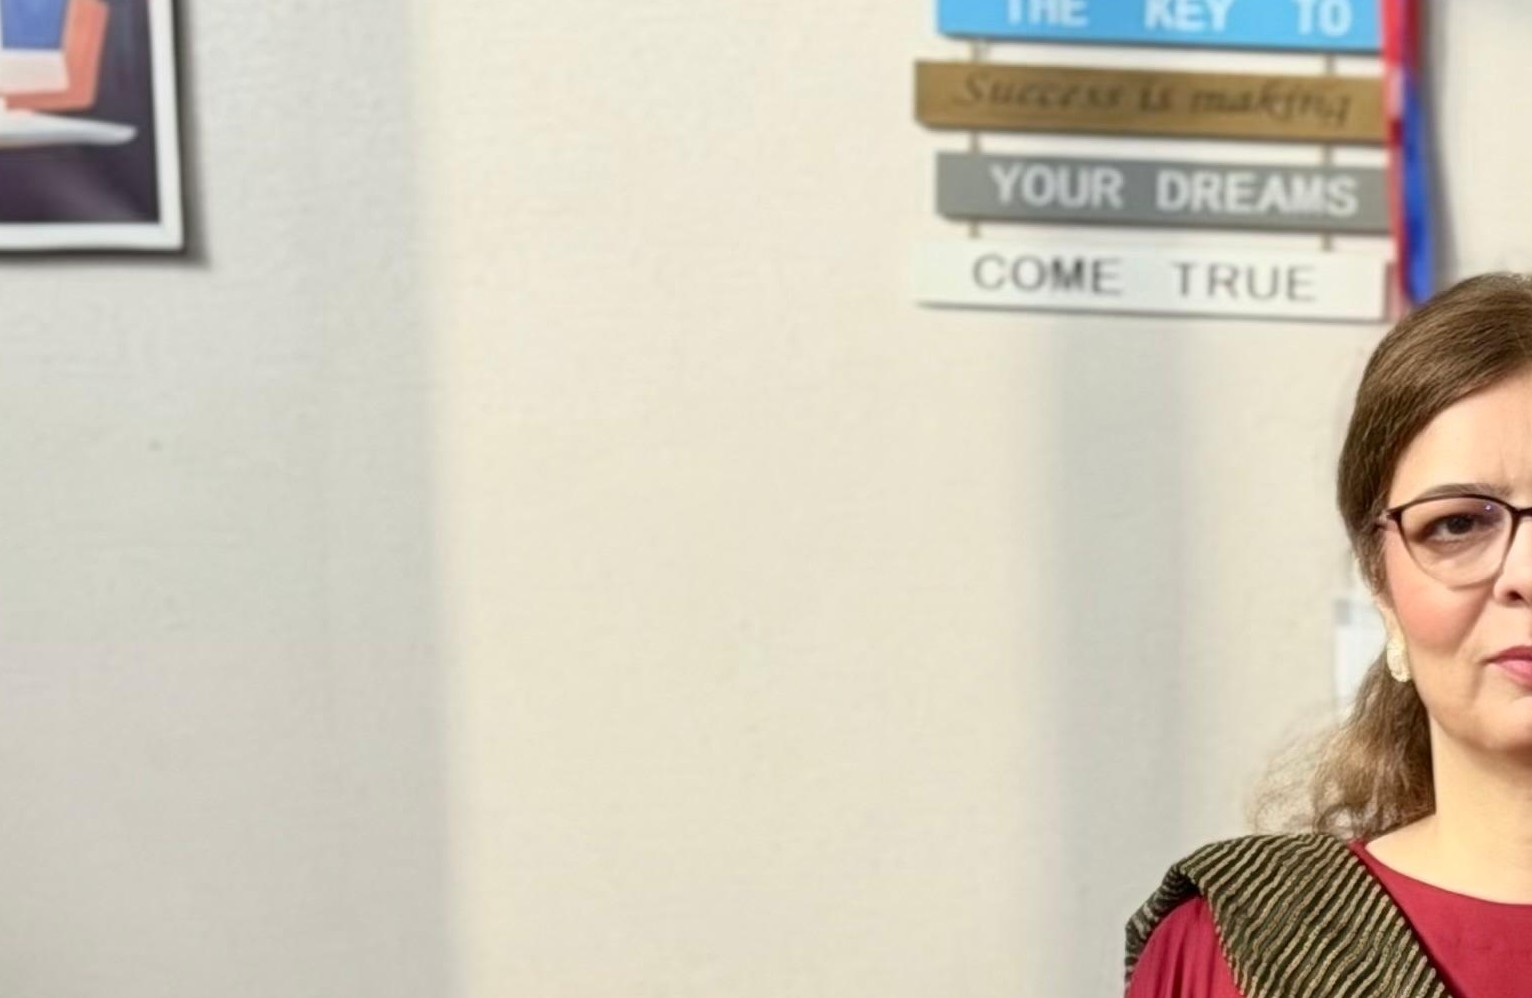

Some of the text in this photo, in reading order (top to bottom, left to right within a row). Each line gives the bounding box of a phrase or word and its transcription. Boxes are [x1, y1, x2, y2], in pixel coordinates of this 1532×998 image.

[1004, 0, 1352, 37] THE KEY TO
[989, 163, 1360, 218] YOUR DREAMS
[972, 252, 1318, 302] COME TRUE
